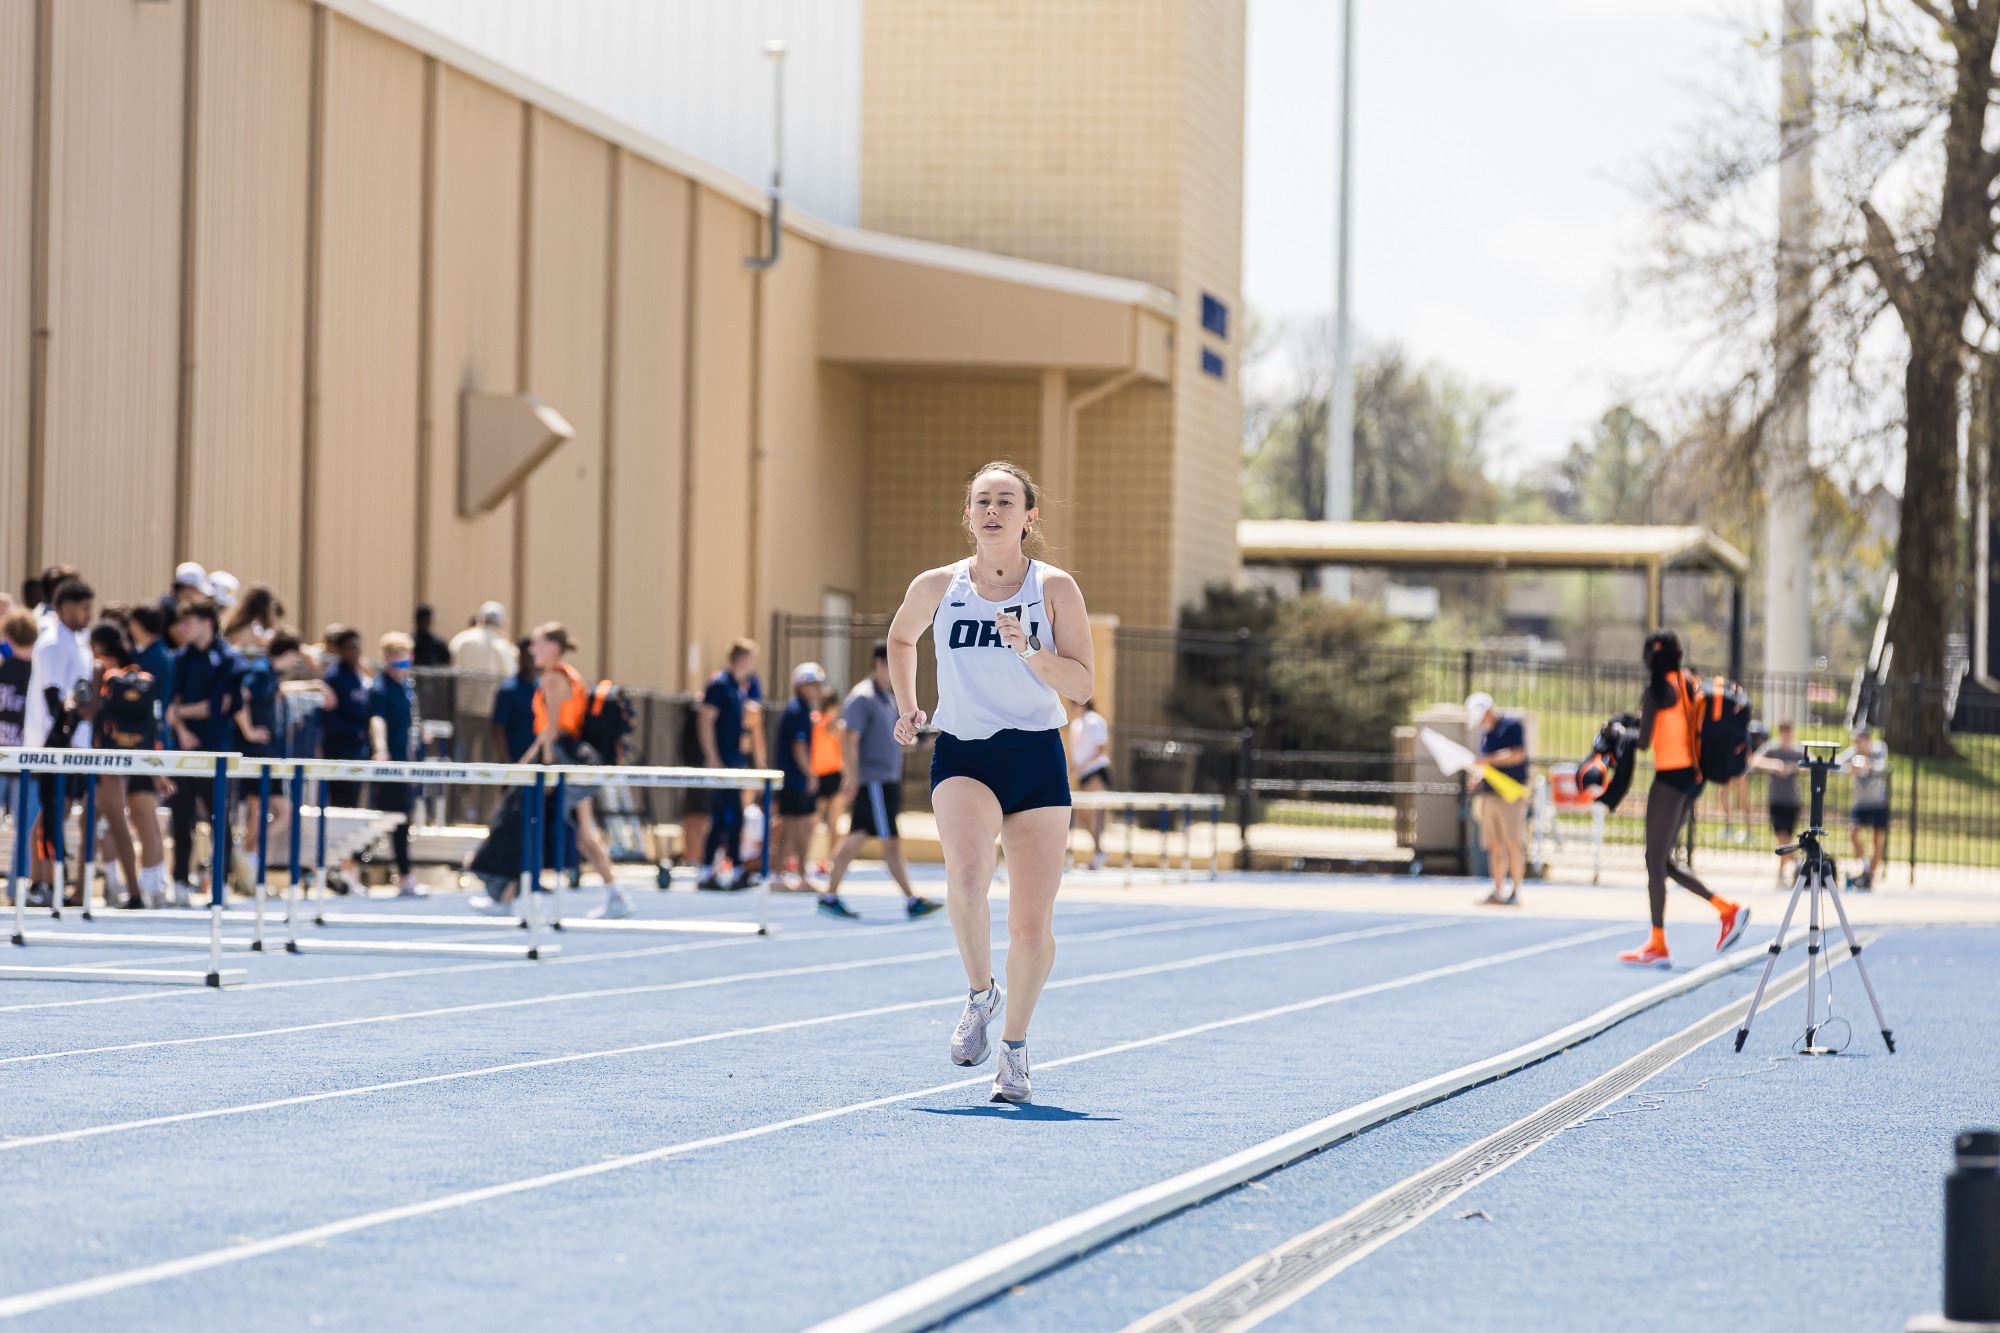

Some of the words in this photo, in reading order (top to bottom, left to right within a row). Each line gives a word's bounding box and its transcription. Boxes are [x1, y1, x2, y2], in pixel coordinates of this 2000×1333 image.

[949, 620, 1039, 649] OR
[19, 753, 57, 765] ORAL
[63, 754, 133, 767] ROBERTS
